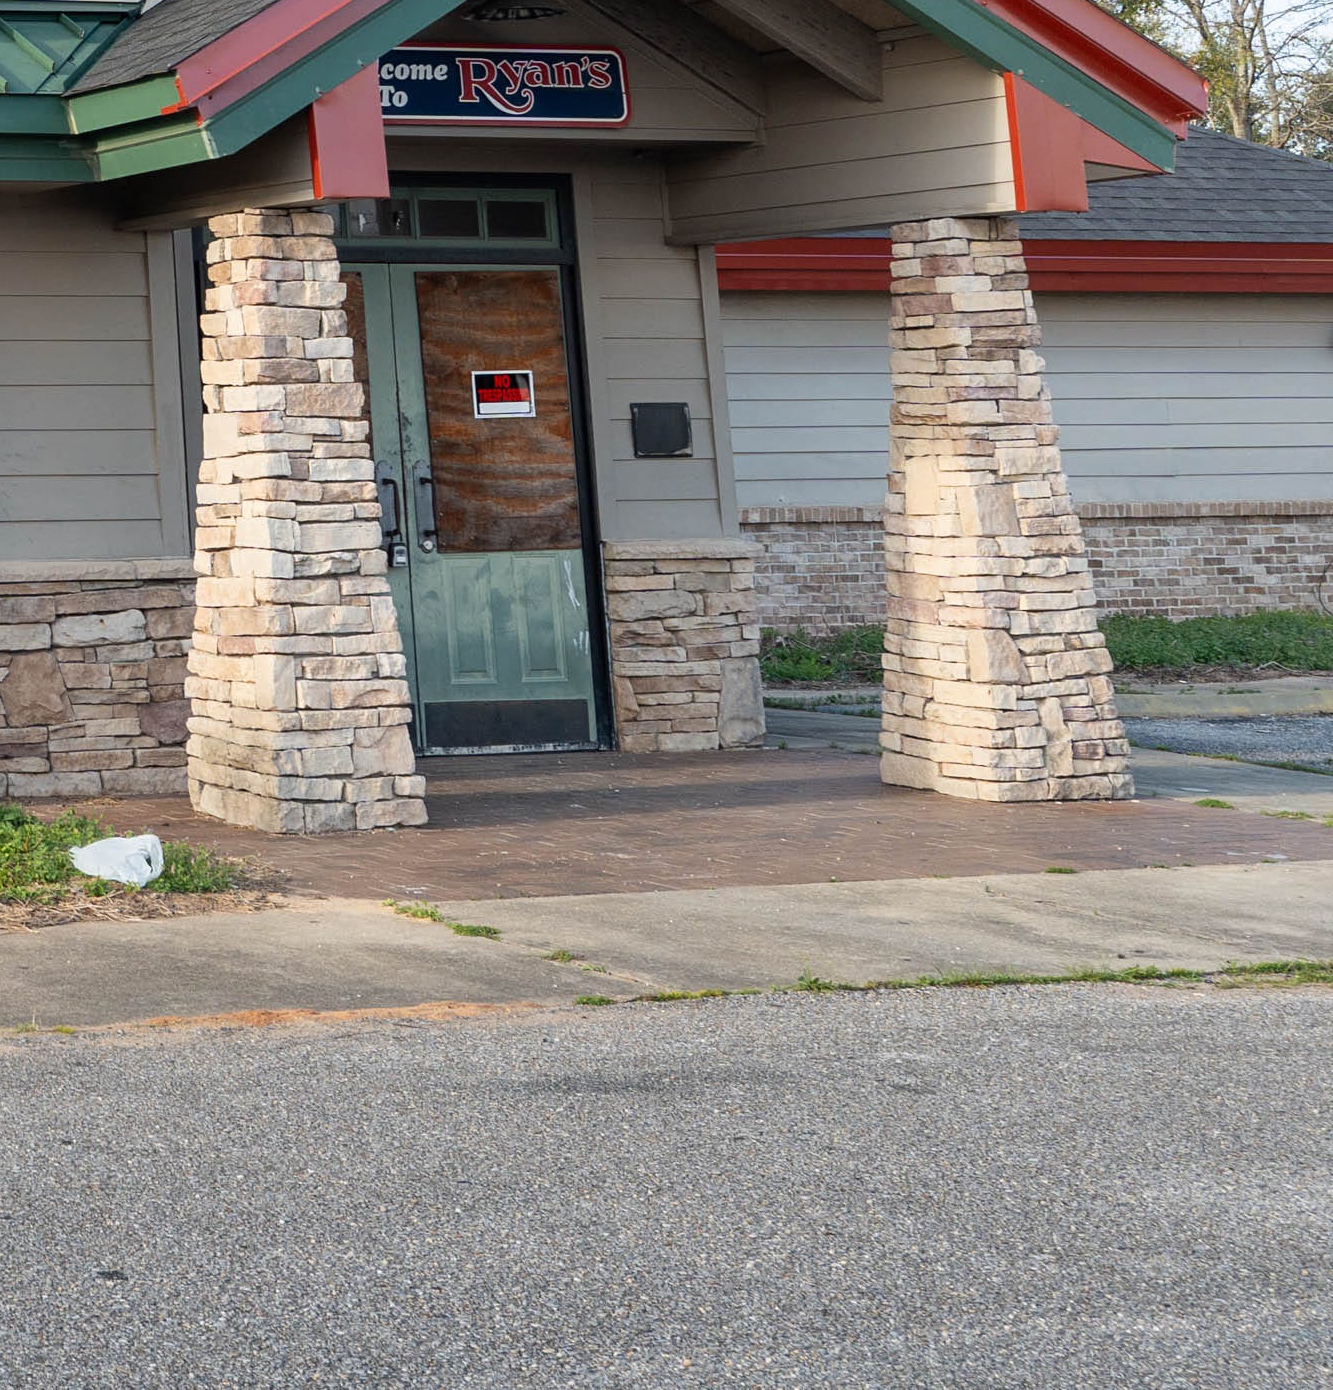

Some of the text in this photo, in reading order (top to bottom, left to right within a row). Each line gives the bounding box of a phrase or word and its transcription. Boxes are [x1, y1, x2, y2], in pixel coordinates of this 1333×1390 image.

[378, 63, 449, 81] come
[455, 57, 612, 115] Ryan's
[378, 85, 409, 108] To
[494, 373, 511, 388] NO
